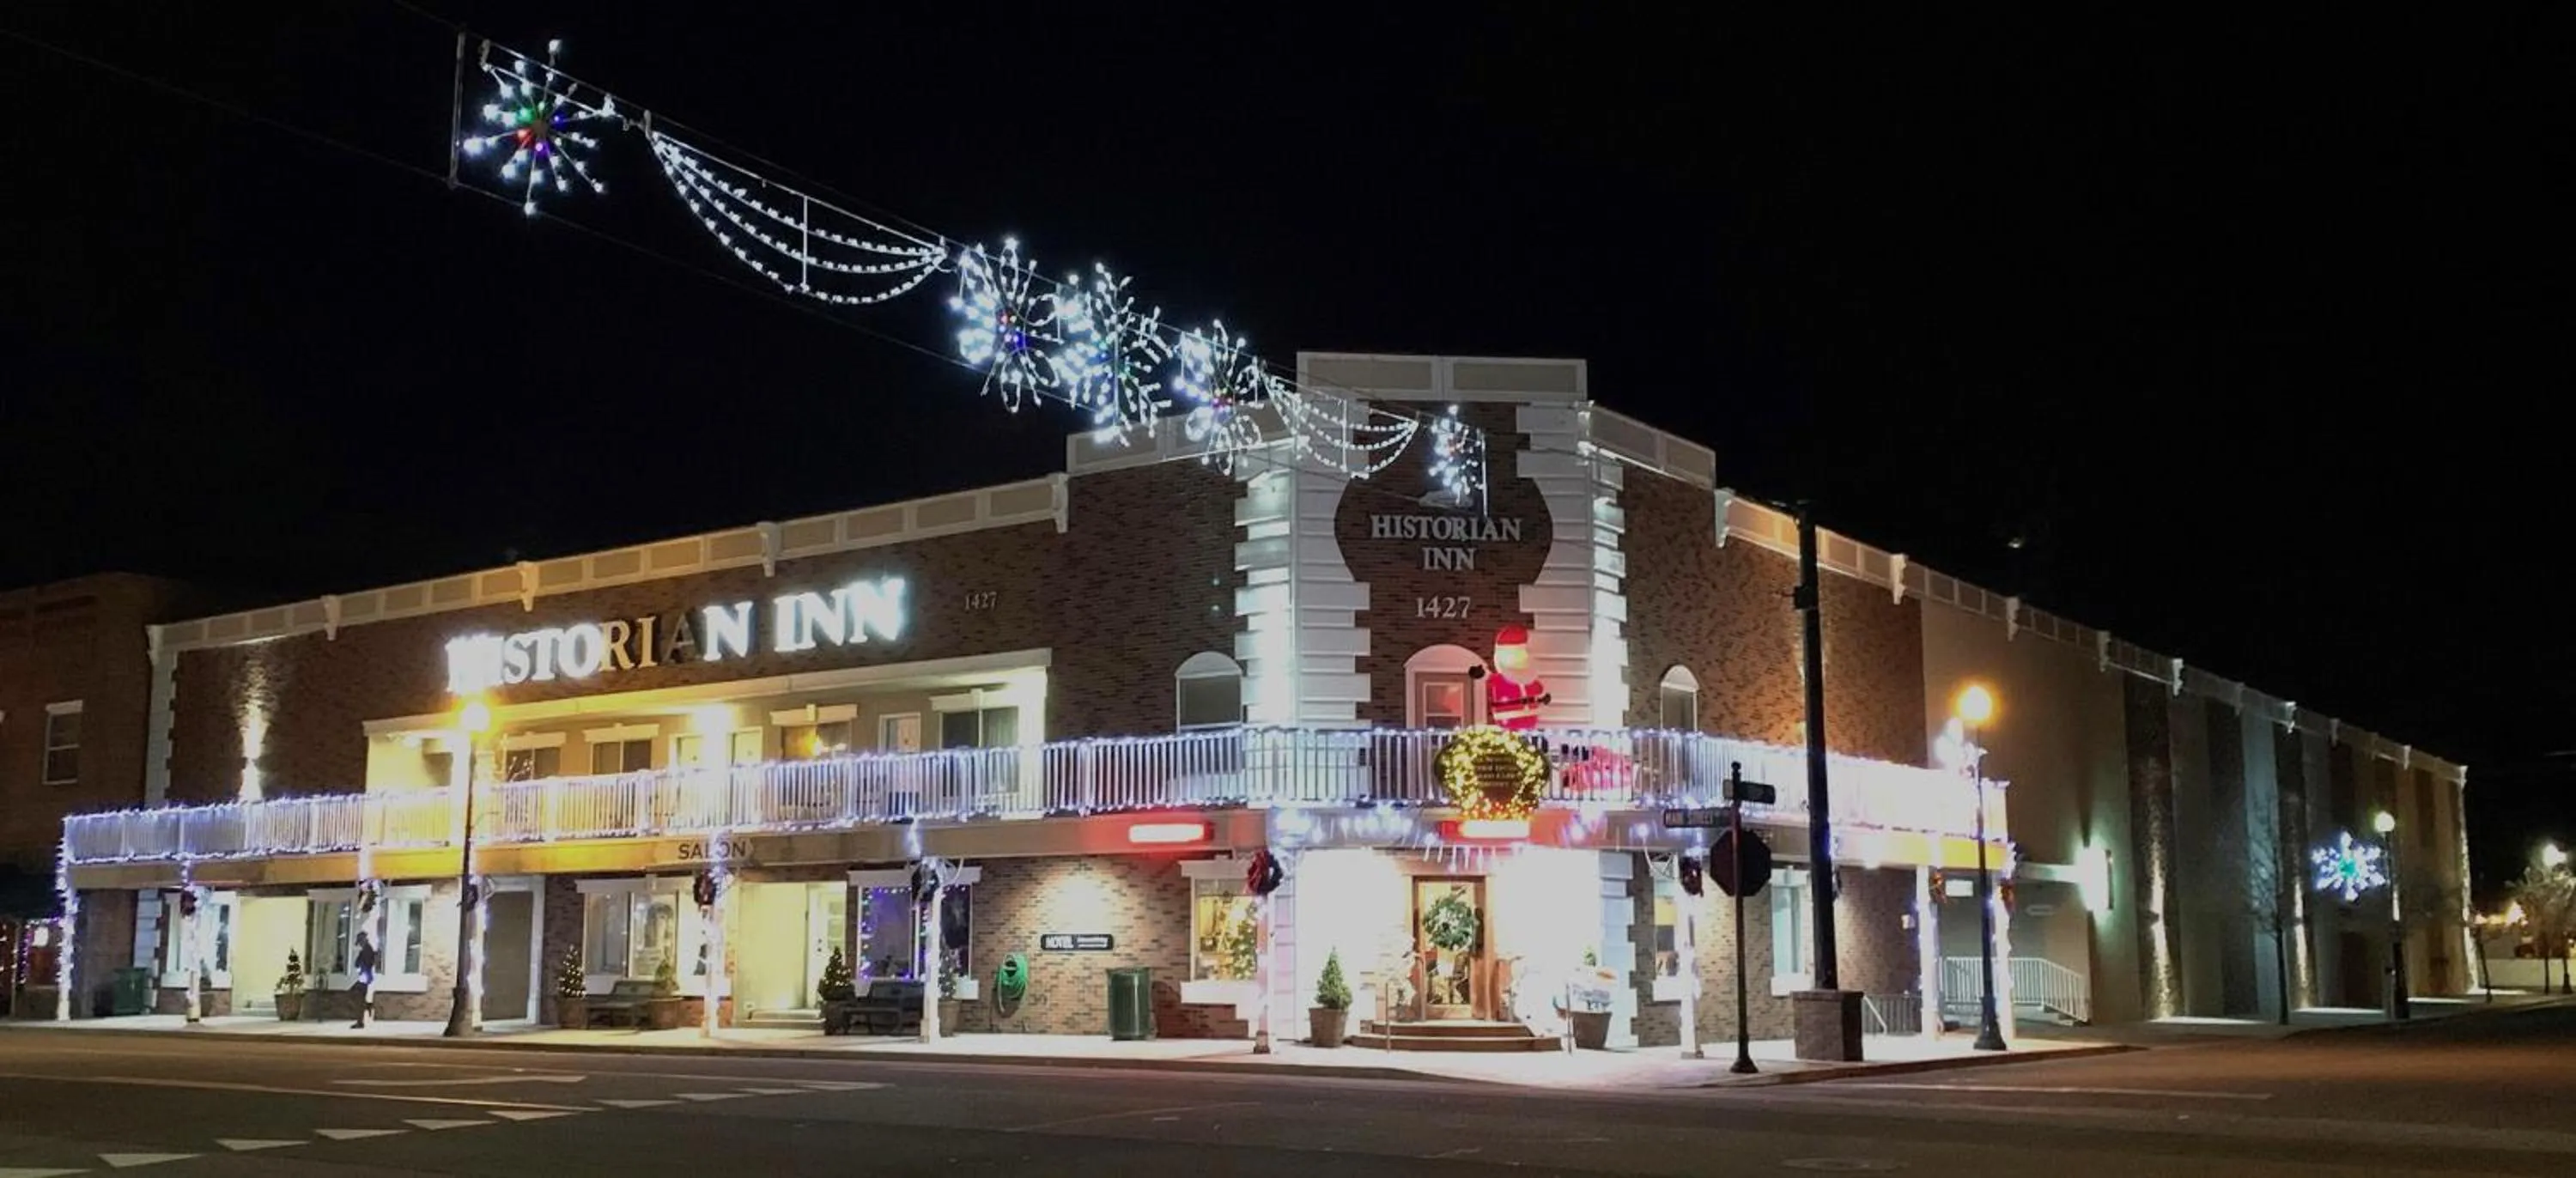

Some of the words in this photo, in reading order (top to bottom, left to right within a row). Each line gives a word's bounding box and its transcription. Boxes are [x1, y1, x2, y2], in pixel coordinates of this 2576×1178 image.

[1371, 514, 1522, 542] HISTORIAN
[1423, 547, 1477, 570] INN
[964, 591, 997, 610] 1427
[1416, 595, 1471, 619] 1427
[774, 574, 905, 653] INN
[677, 841, 746, 860] SALON
